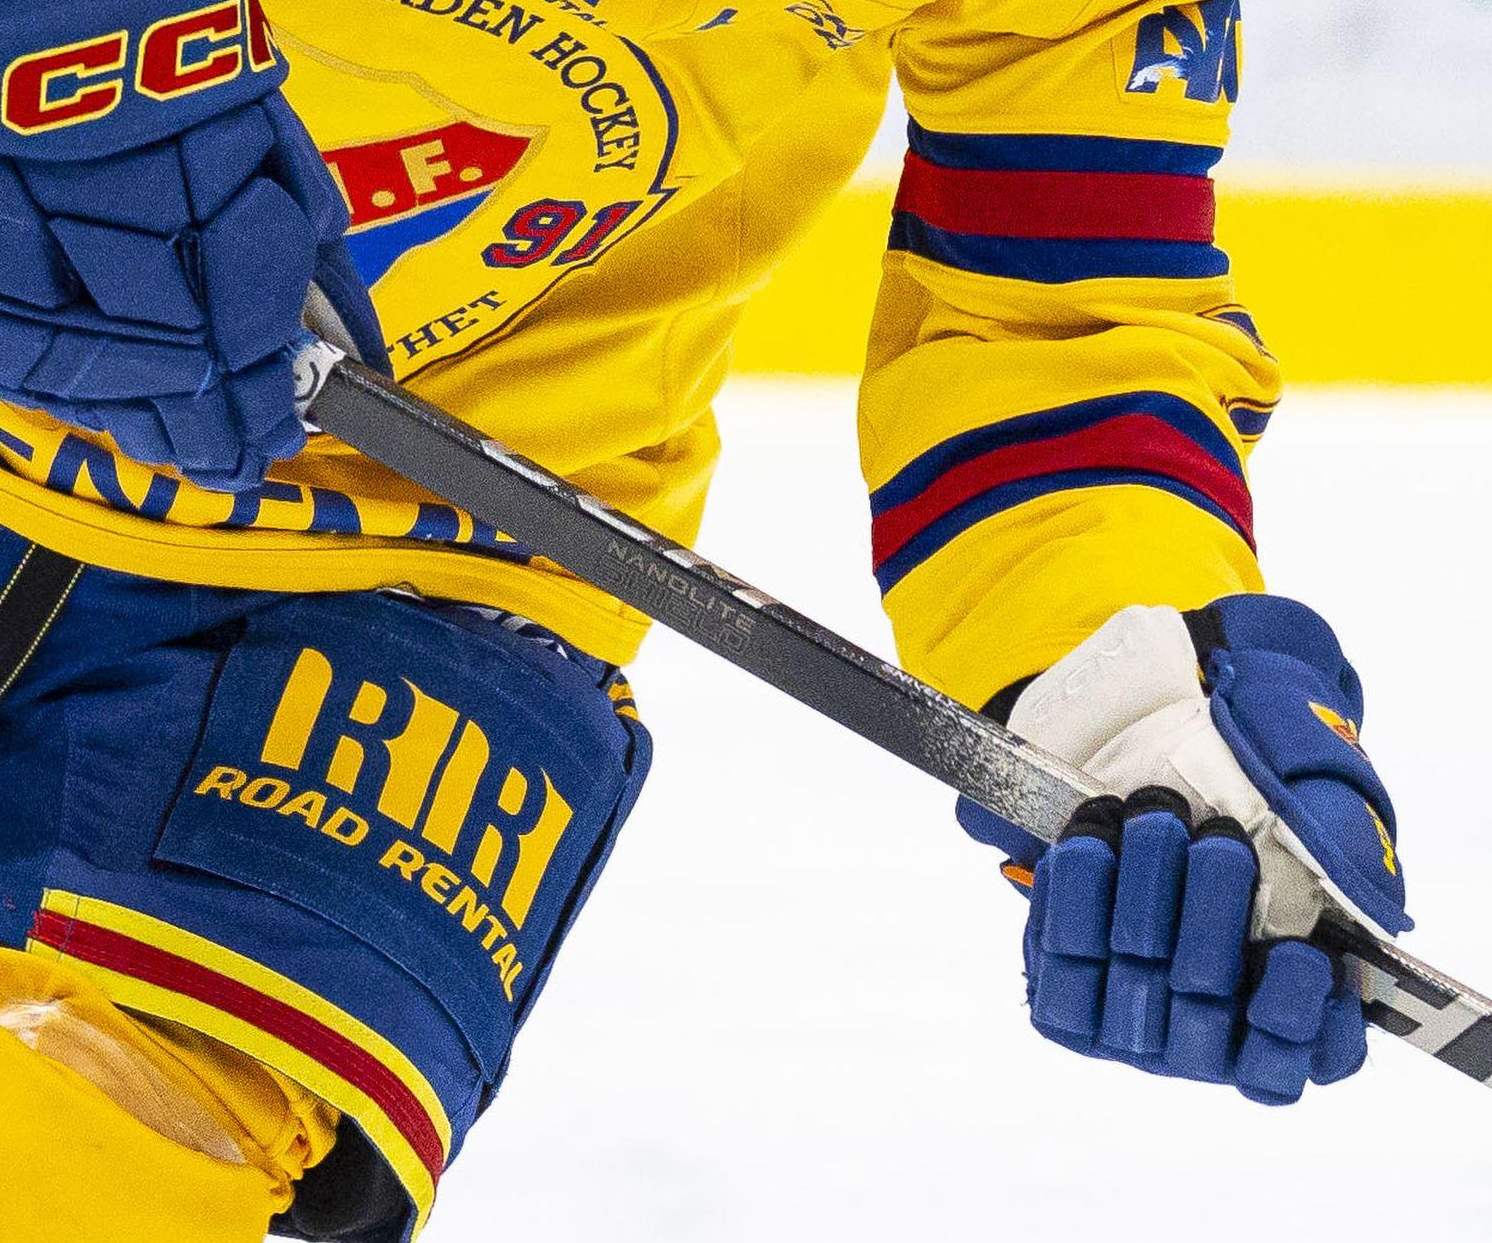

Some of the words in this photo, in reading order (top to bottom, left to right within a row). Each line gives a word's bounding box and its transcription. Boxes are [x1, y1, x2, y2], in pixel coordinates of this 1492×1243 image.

[531, 32, 641, 174] HOCKEY
[480, 197, 644, 269] 91
[385, 290, 508, 360] HET
[606, 538, 758, 636] NANOLITE
[194, 765, 371, 848] ROAD
[378, 838, 524, 1003] RENTAL
